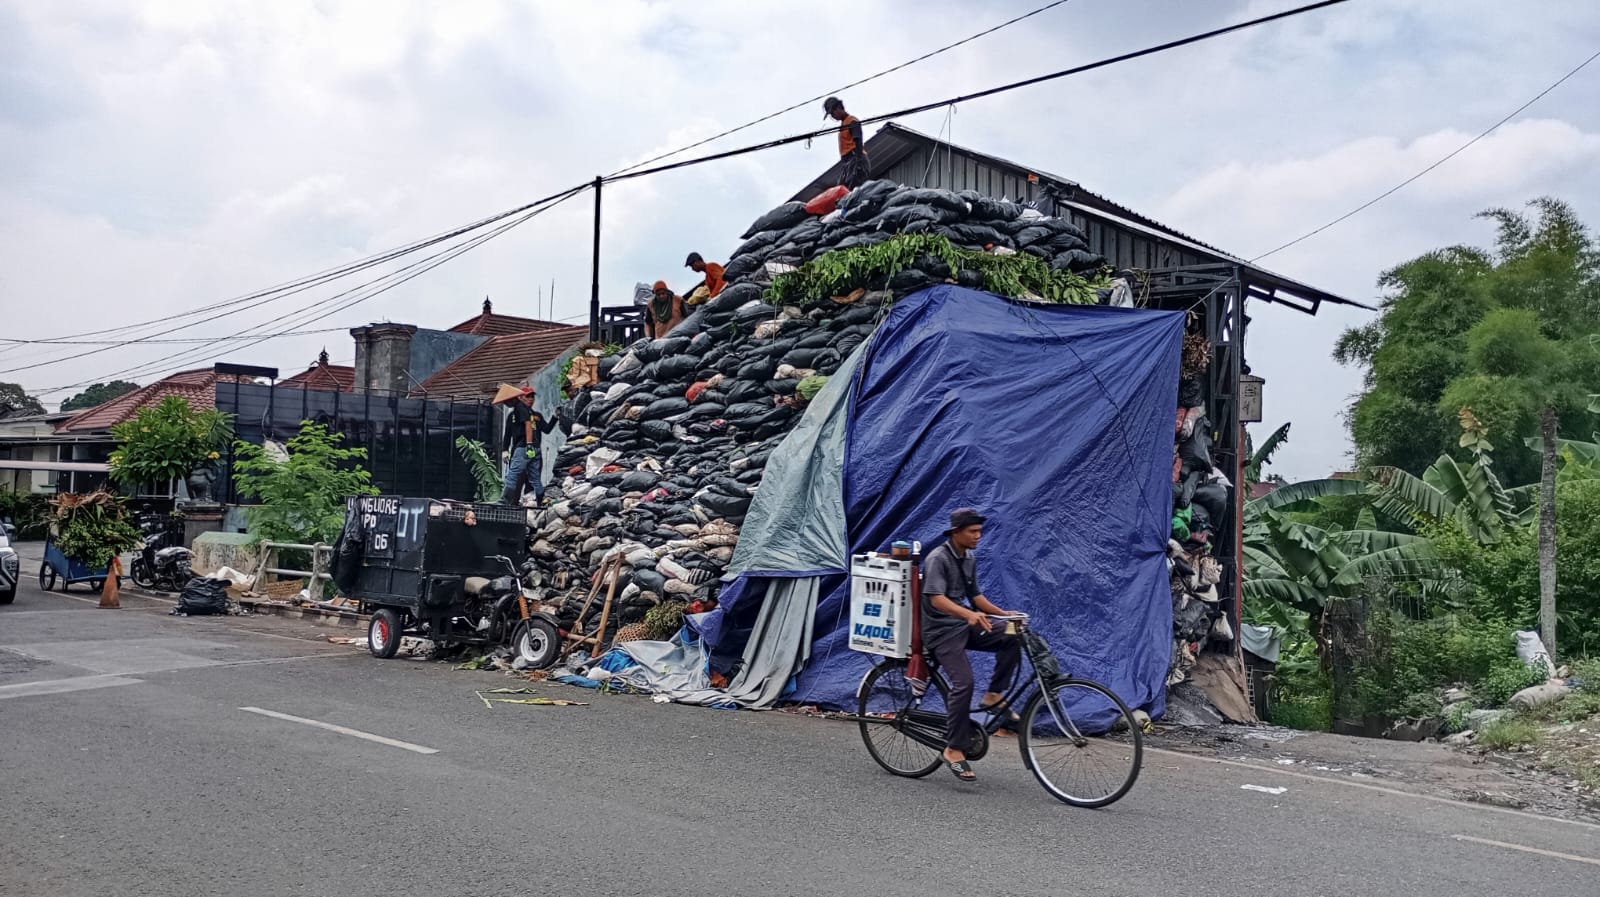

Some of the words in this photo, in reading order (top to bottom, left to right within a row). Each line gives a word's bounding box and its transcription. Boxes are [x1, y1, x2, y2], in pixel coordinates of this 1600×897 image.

[374, 533, 389, 550] 06
[863, 602, 882, 617] ES
[854, 622, 891, 640] KADO
